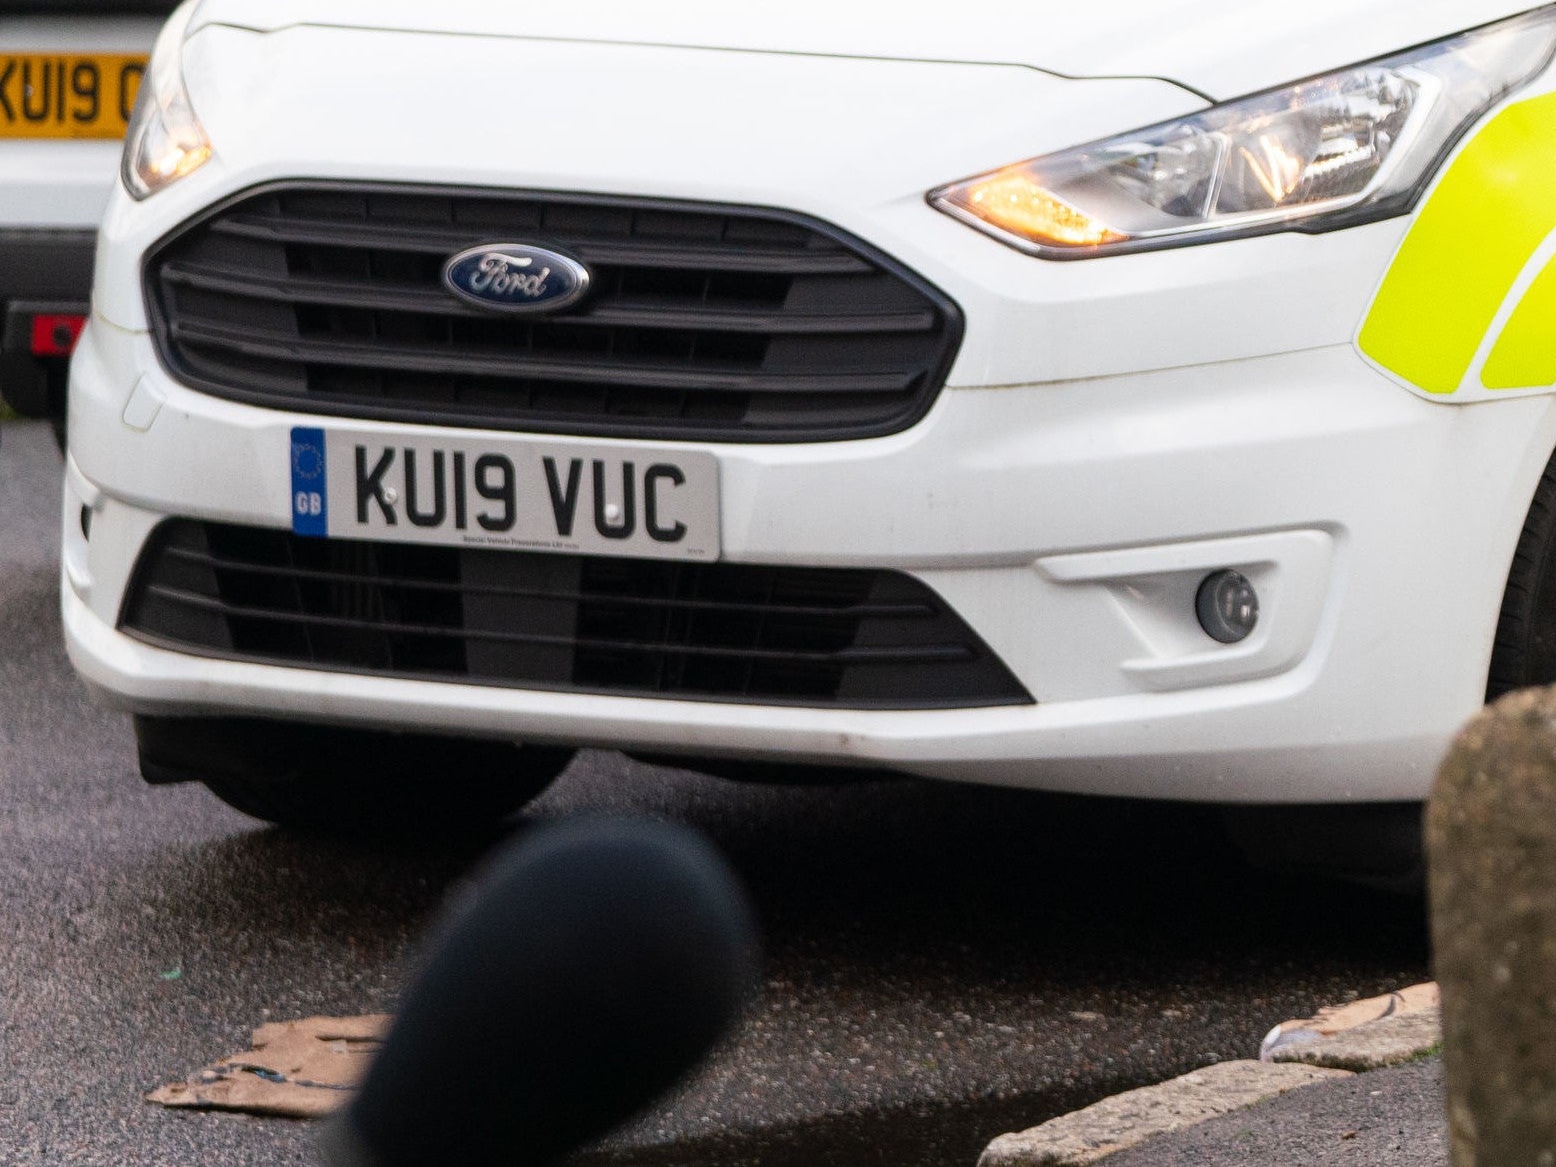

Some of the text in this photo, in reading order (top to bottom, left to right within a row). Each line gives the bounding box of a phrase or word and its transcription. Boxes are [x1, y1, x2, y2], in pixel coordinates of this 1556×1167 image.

[469, 252, 551, 297] Ford
[296, 492, 322, 514] GB
[355, 444, 688, 542] KU19 VUC
